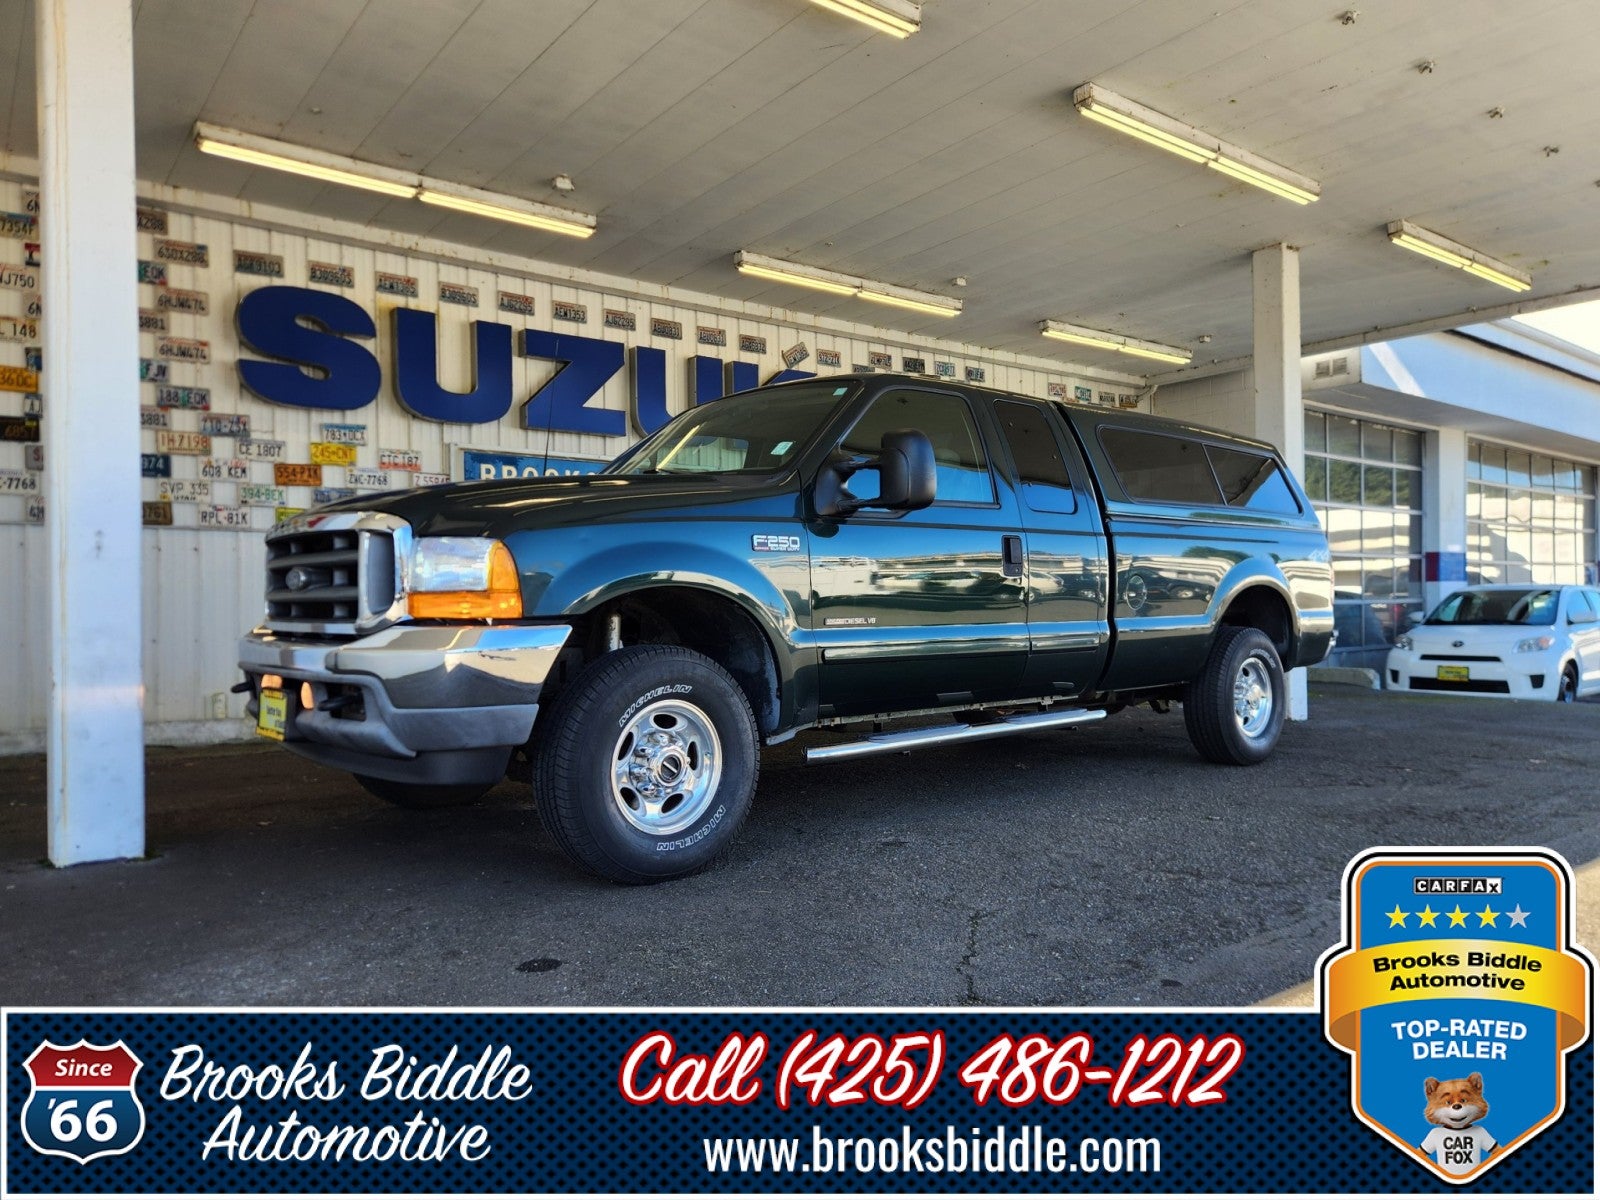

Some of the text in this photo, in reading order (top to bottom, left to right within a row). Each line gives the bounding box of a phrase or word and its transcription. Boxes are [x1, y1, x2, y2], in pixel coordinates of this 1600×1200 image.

[480, 463, 597, 482] BRO
[619, 684, 693, 728] MICHELIN
[656, 804, 727, 851] MICHELIN
